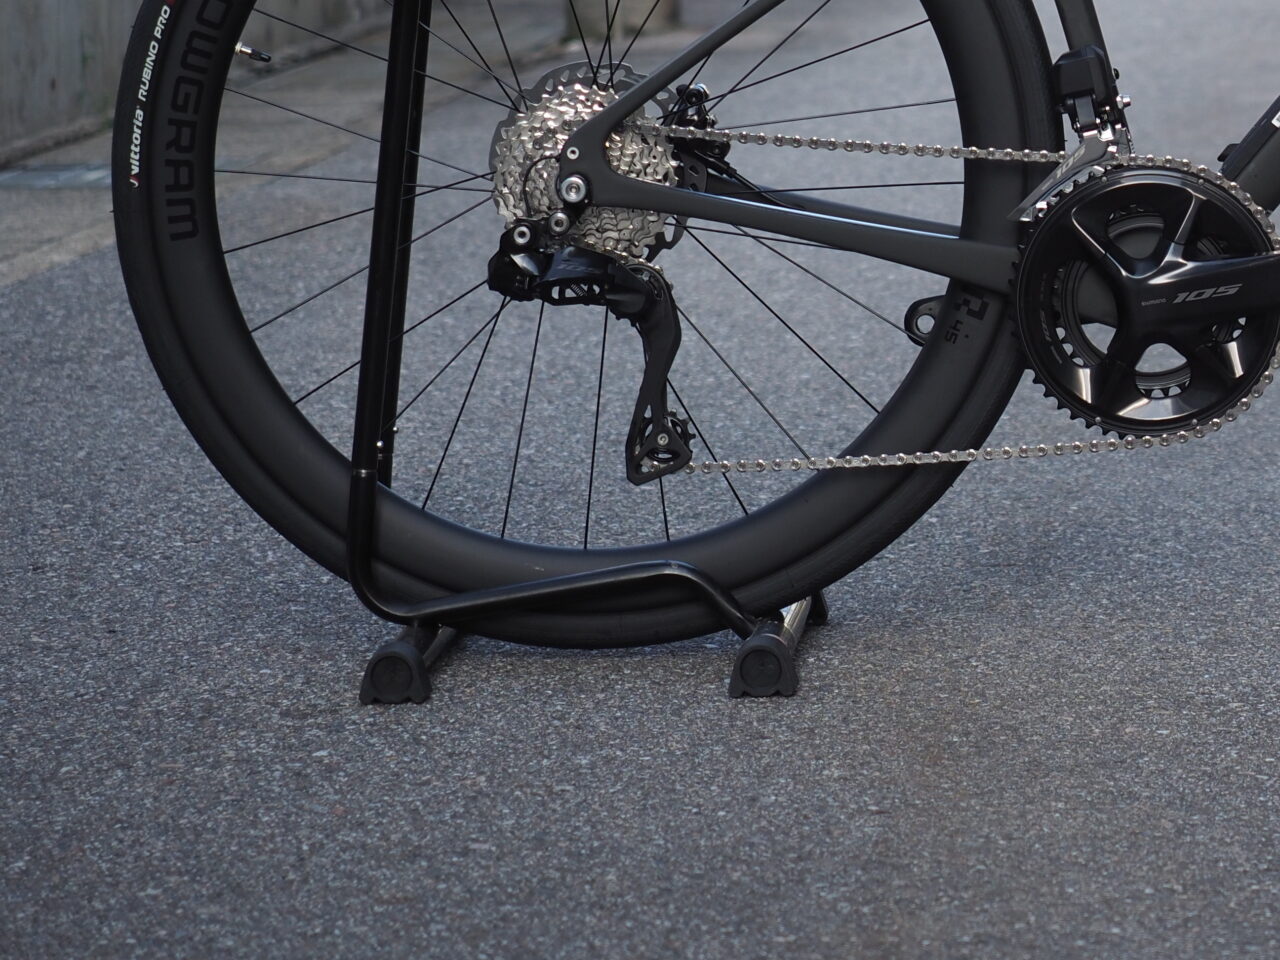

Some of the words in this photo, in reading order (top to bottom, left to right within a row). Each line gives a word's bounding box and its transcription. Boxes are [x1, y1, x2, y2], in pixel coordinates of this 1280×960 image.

[138, 43, 159, 102] RUBINO
[154, 5, 171, 40] PRO
[1056, 144, 1086, 178] 105
[1172, 283, 1243, 304] 105
